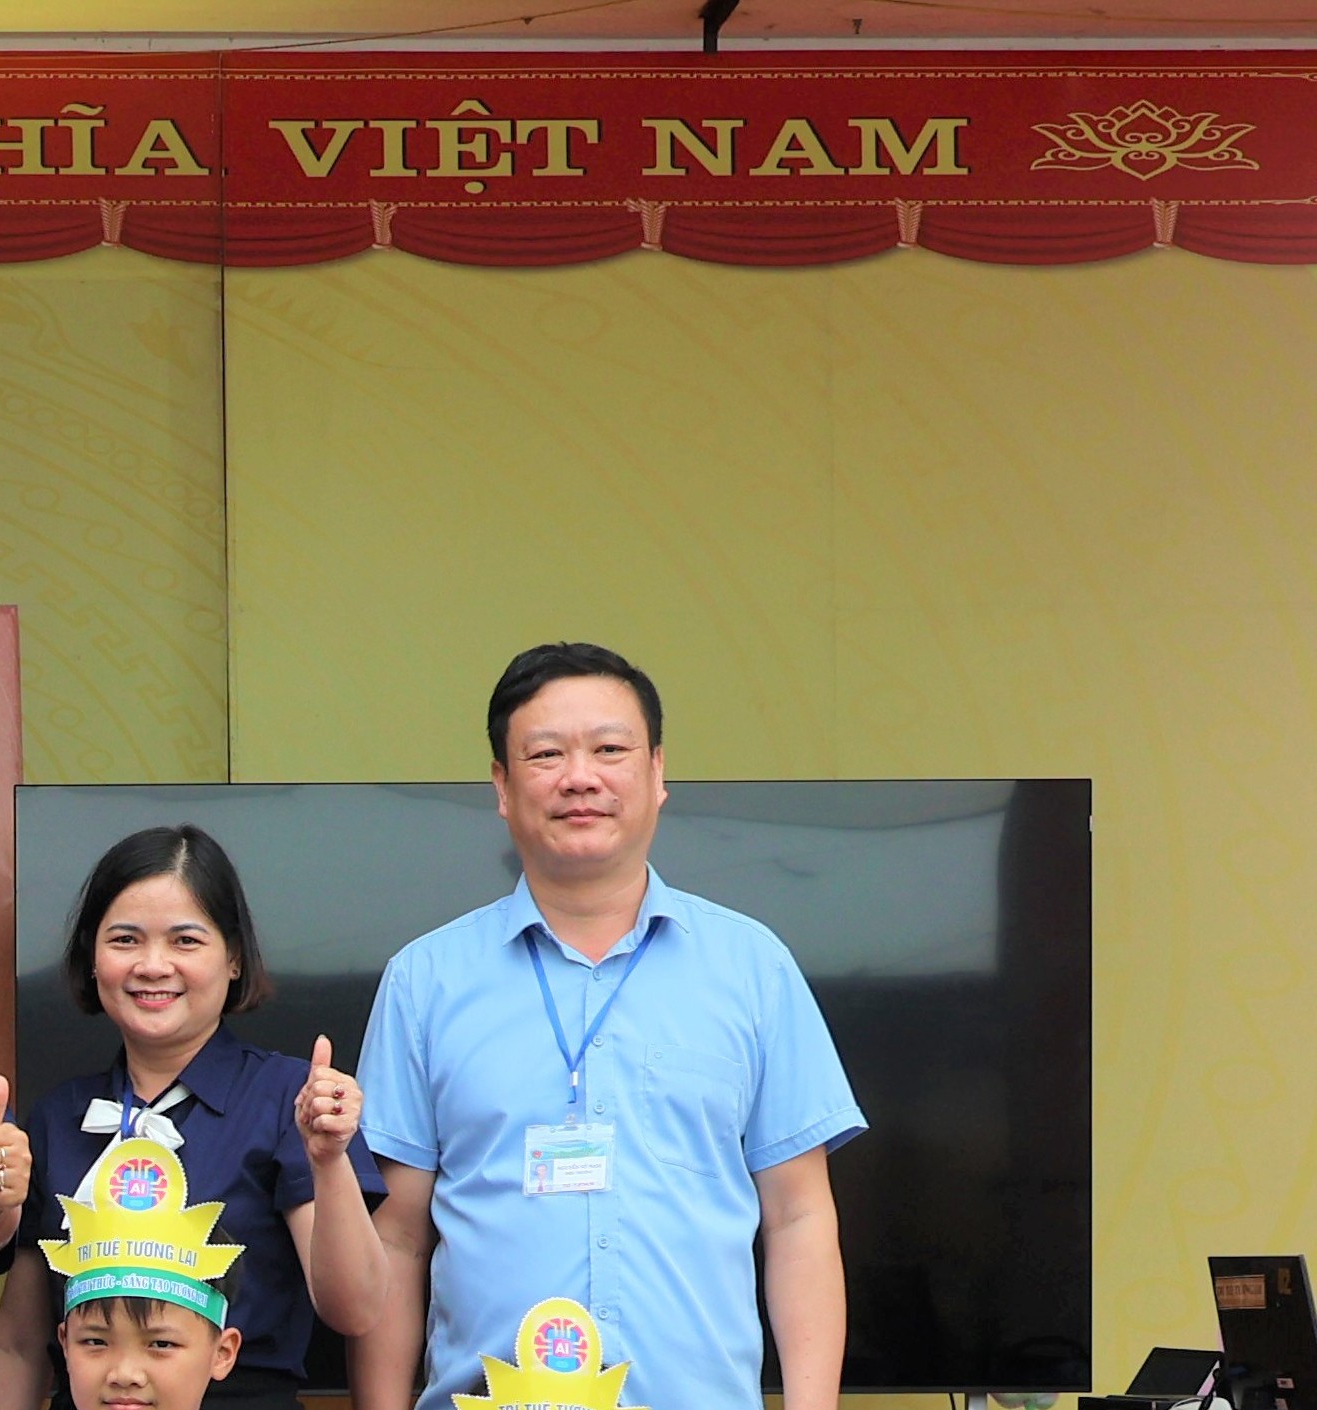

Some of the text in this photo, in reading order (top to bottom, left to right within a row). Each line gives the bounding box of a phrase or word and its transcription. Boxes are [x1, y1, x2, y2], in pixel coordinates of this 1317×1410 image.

[268, 98, 600, 195] VIỆT
[642, 117, 971, 178] NAM
[130, 1184, 146, 1195] AI
[178, 1248, 197, 1267] LAI
[555, 1342, 571, 1354] AI
